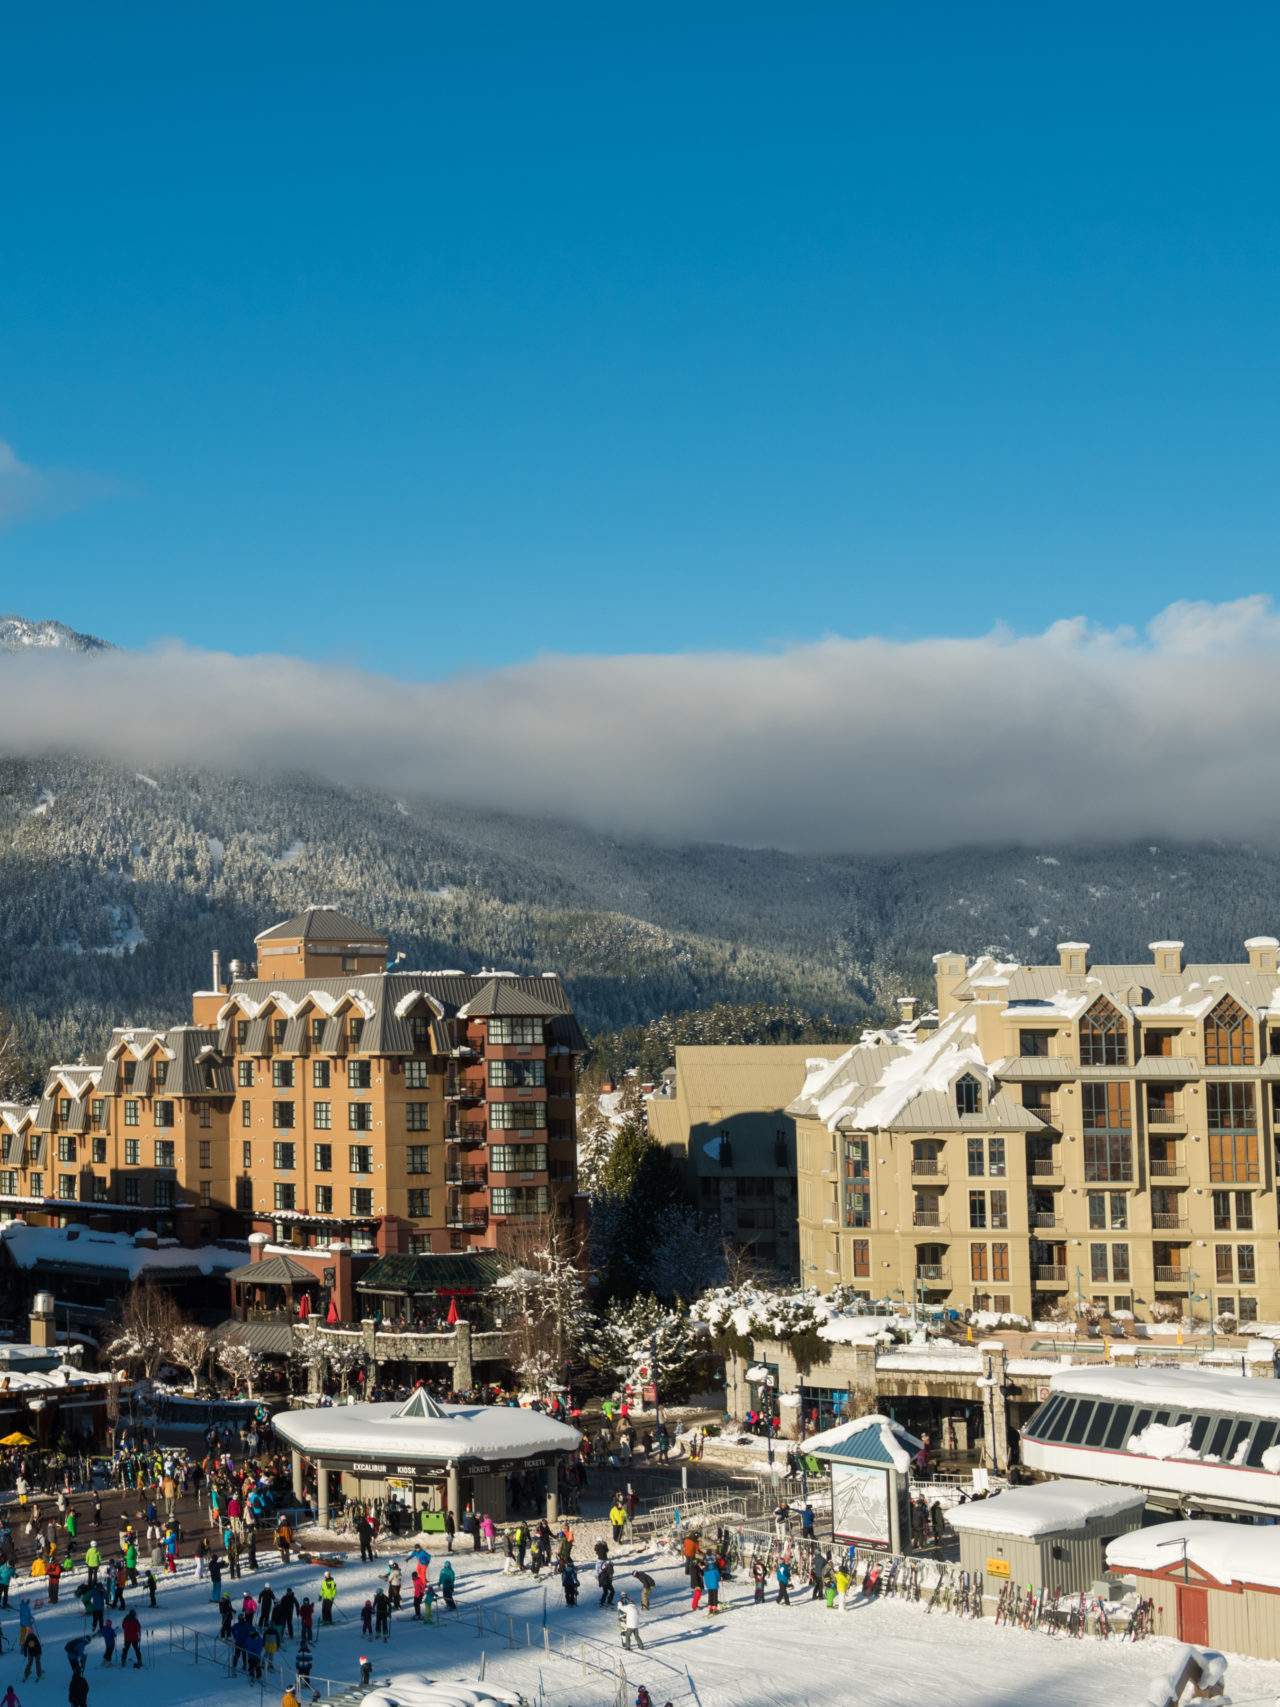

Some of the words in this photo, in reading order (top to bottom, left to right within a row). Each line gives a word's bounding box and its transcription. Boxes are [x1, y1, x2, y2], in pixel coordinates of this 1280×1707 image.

[524, 1459, 546, 1467] TICKETS
[353, 1463, 387, 1473] EXCALIBUR
[397, 1466, 416, 1475] KIOSK
[469, 1465, 491, 1474] TICKETS
